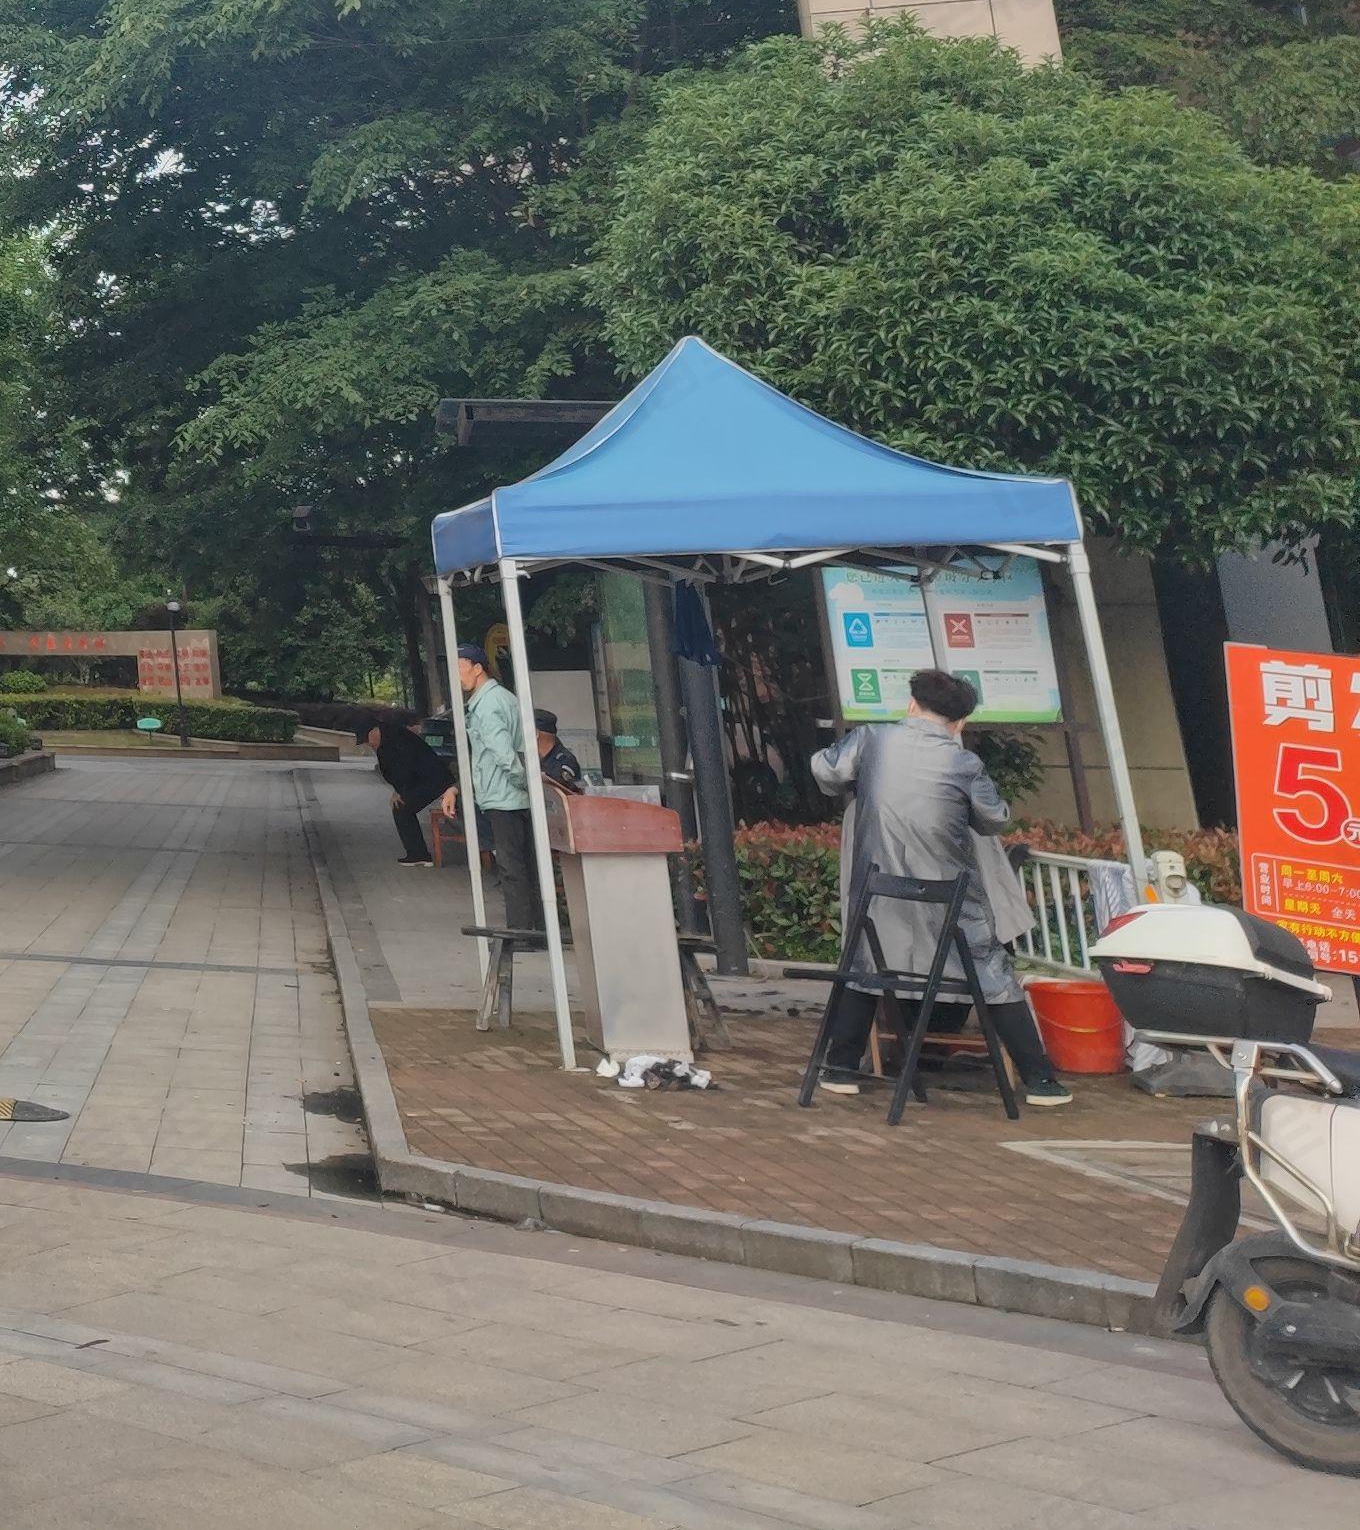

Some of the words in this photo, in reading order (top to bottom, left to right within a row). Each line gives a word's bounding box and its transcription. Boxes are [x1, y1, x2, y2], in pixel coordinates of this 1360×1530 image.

[1260, 661, 1360, 734] 剪
[1281, 865, 1343, 884] 周一至周六
